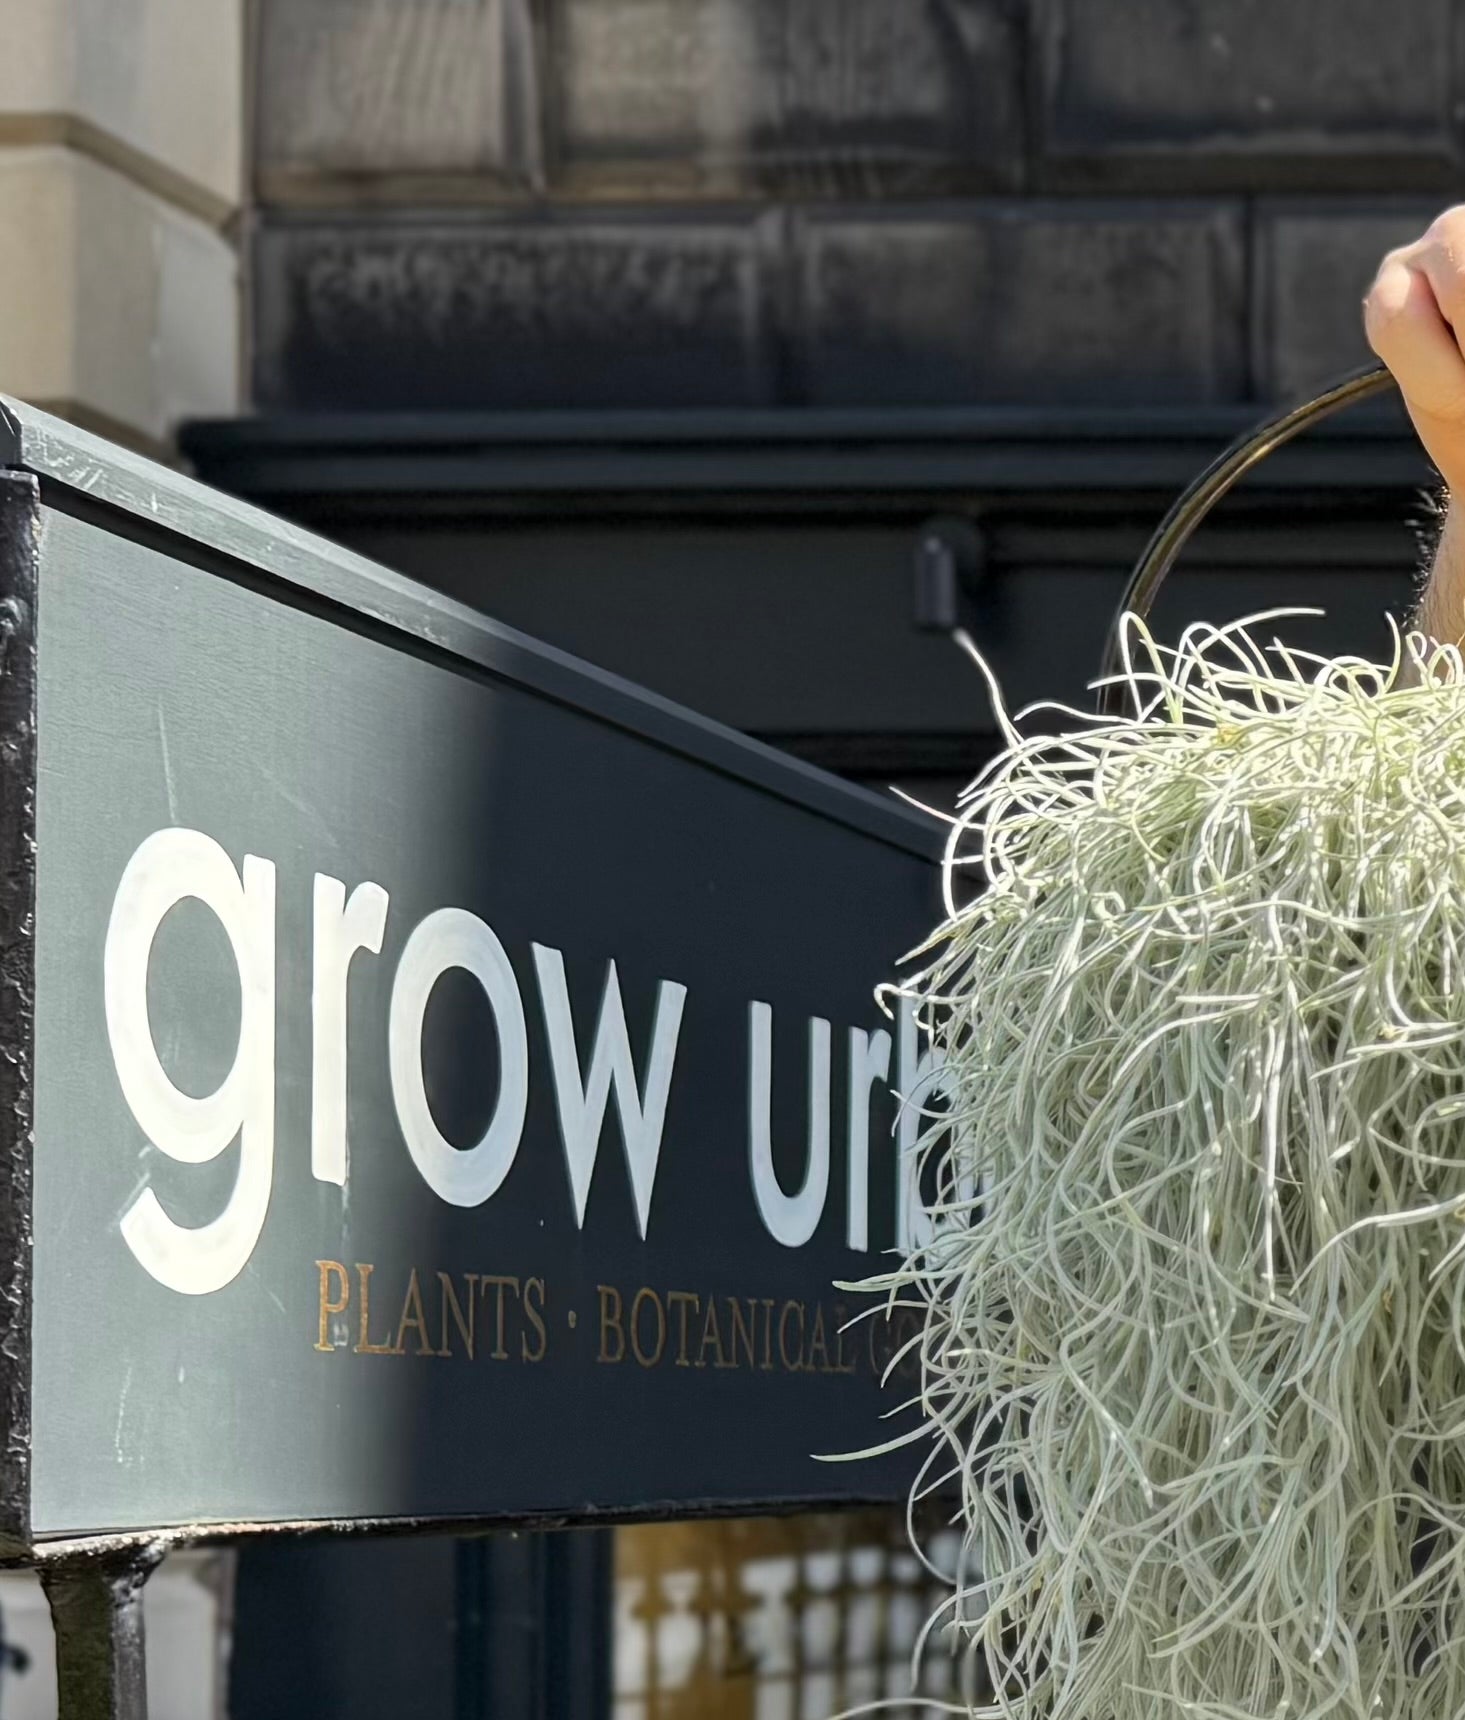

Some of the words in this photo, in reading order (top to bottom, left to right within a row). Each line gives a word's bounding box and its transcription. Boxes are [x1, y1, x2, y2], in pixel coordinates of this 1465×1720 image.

[104, 827, 688, 1295] grow
[749, 977, 1000, 1268] urb
[313, 1259, 546, 1362] PLANTS
[597, 1284, 856, 1374] BOTANICAL
